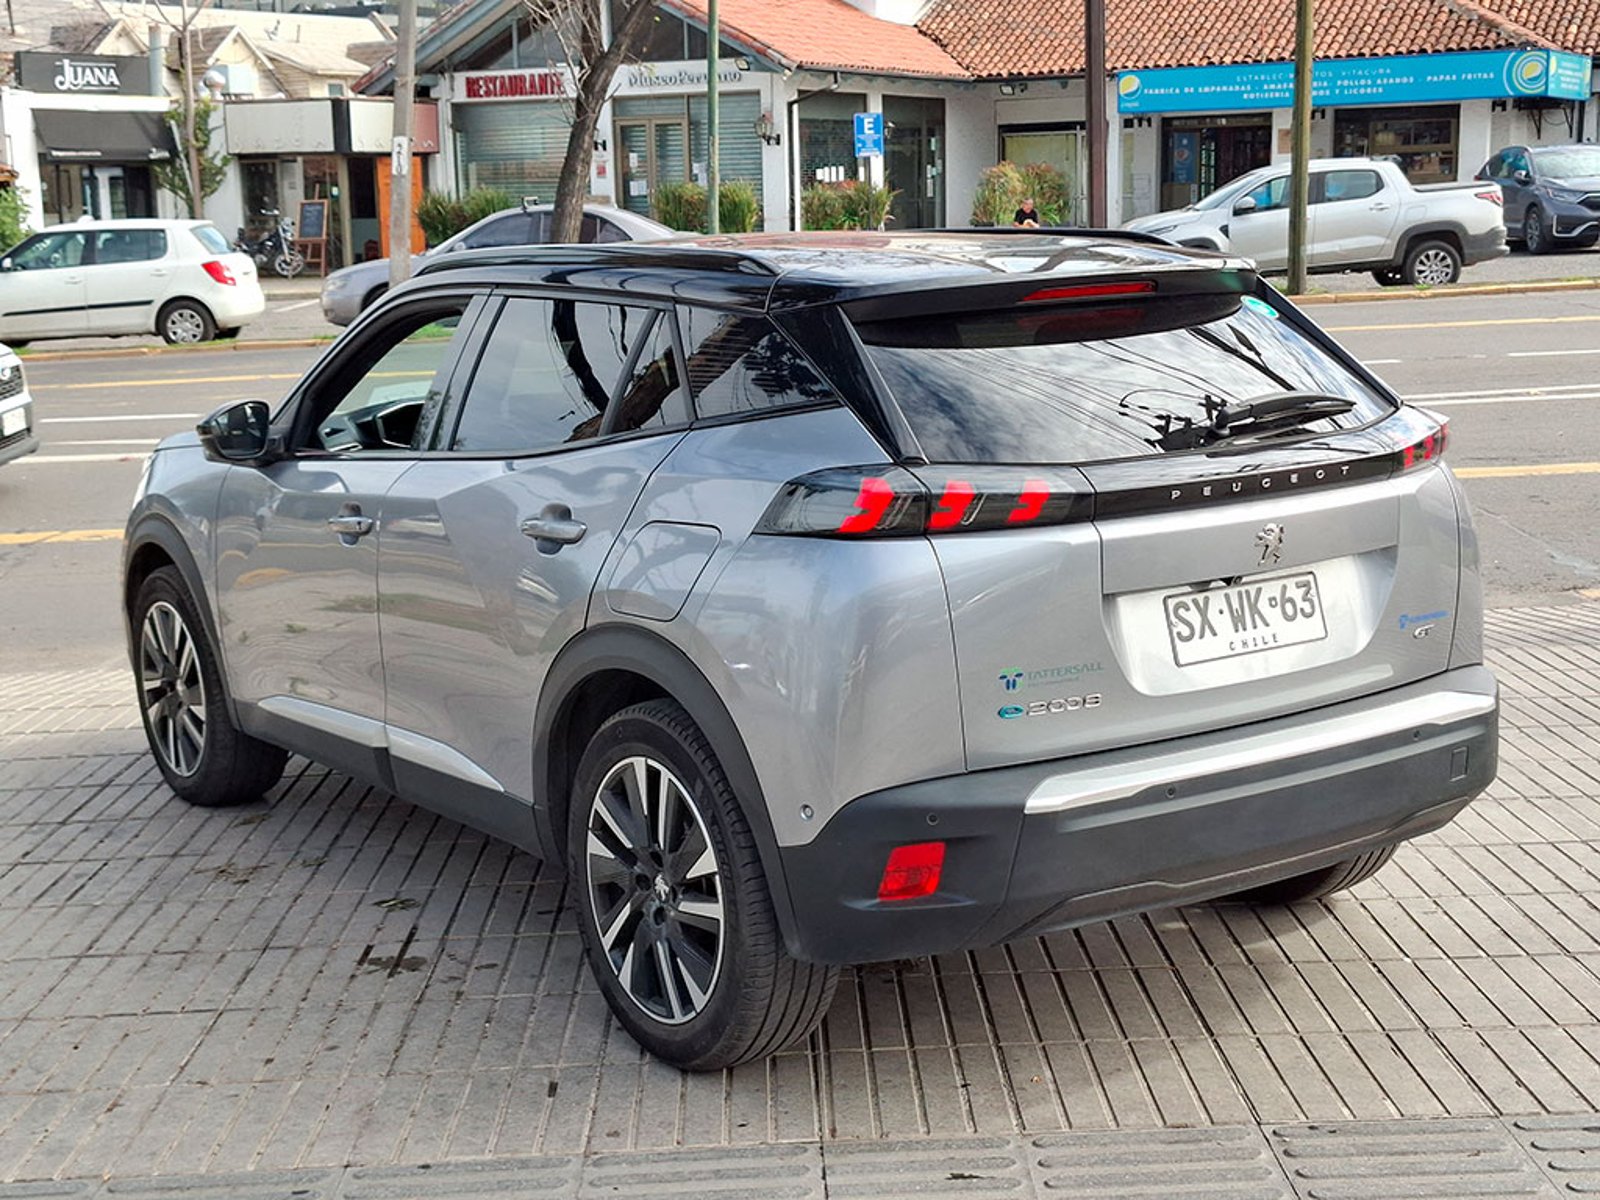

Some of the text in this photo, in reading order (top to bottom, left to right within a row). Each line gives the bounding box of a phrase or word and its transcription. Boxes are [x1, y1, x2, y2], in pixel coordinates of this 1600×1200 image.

[1336, 79, 1372, 87] POLLOS
[1426, 74, 1458, 82] PAPAS
[1462, 72, 1495, 80] FRITAS
[863, 118, 875, 134] E
[1171, 466, 1350, 500] PEUGEOT
[1229, 633, 1279, 651] CHILE
[1027, 662, 1104, 680] TATTERSALL
[1026, 692, 1102, 716] 2008
